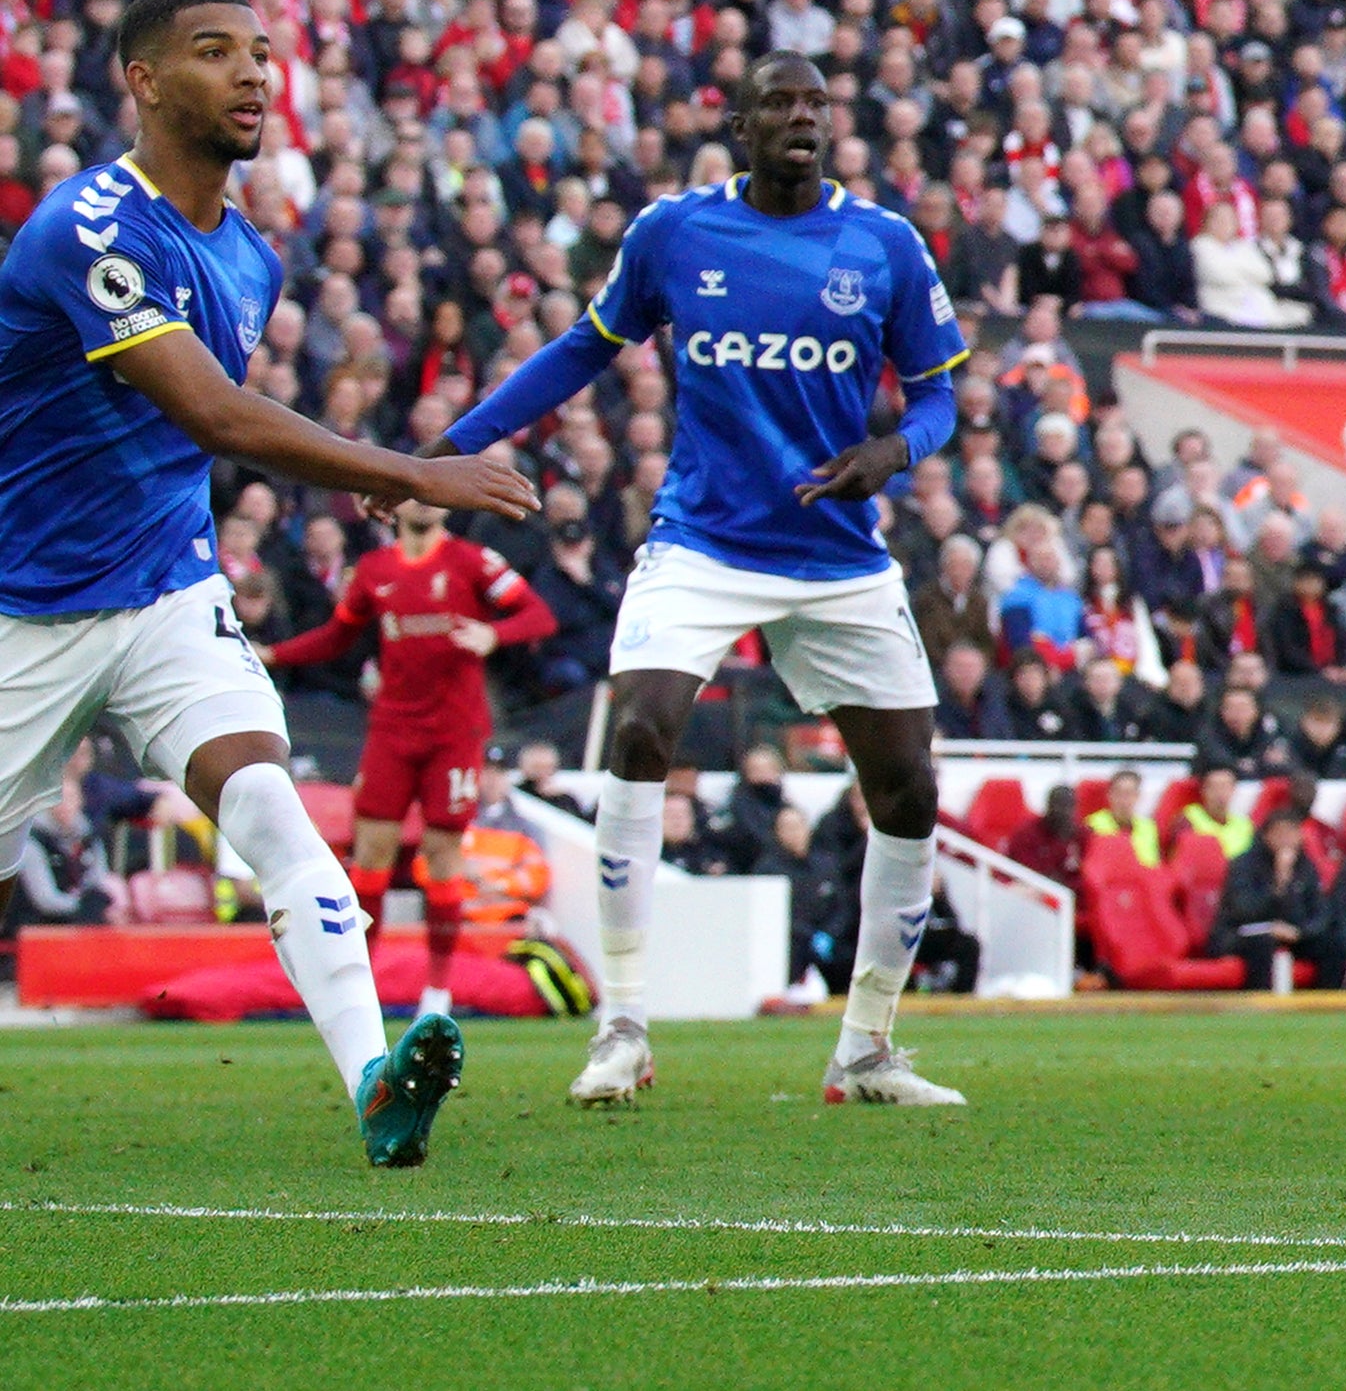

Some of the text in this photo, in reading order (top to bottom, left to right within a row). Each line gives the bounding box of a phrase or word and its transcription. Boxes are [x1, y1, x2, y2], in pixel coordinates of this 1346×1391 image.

[109, 308, 159, 329] No room
[131, 315, 168, 334] racism
[687, 331, 856, 373] CAZOO
[448, 767, 477, 800] 14
